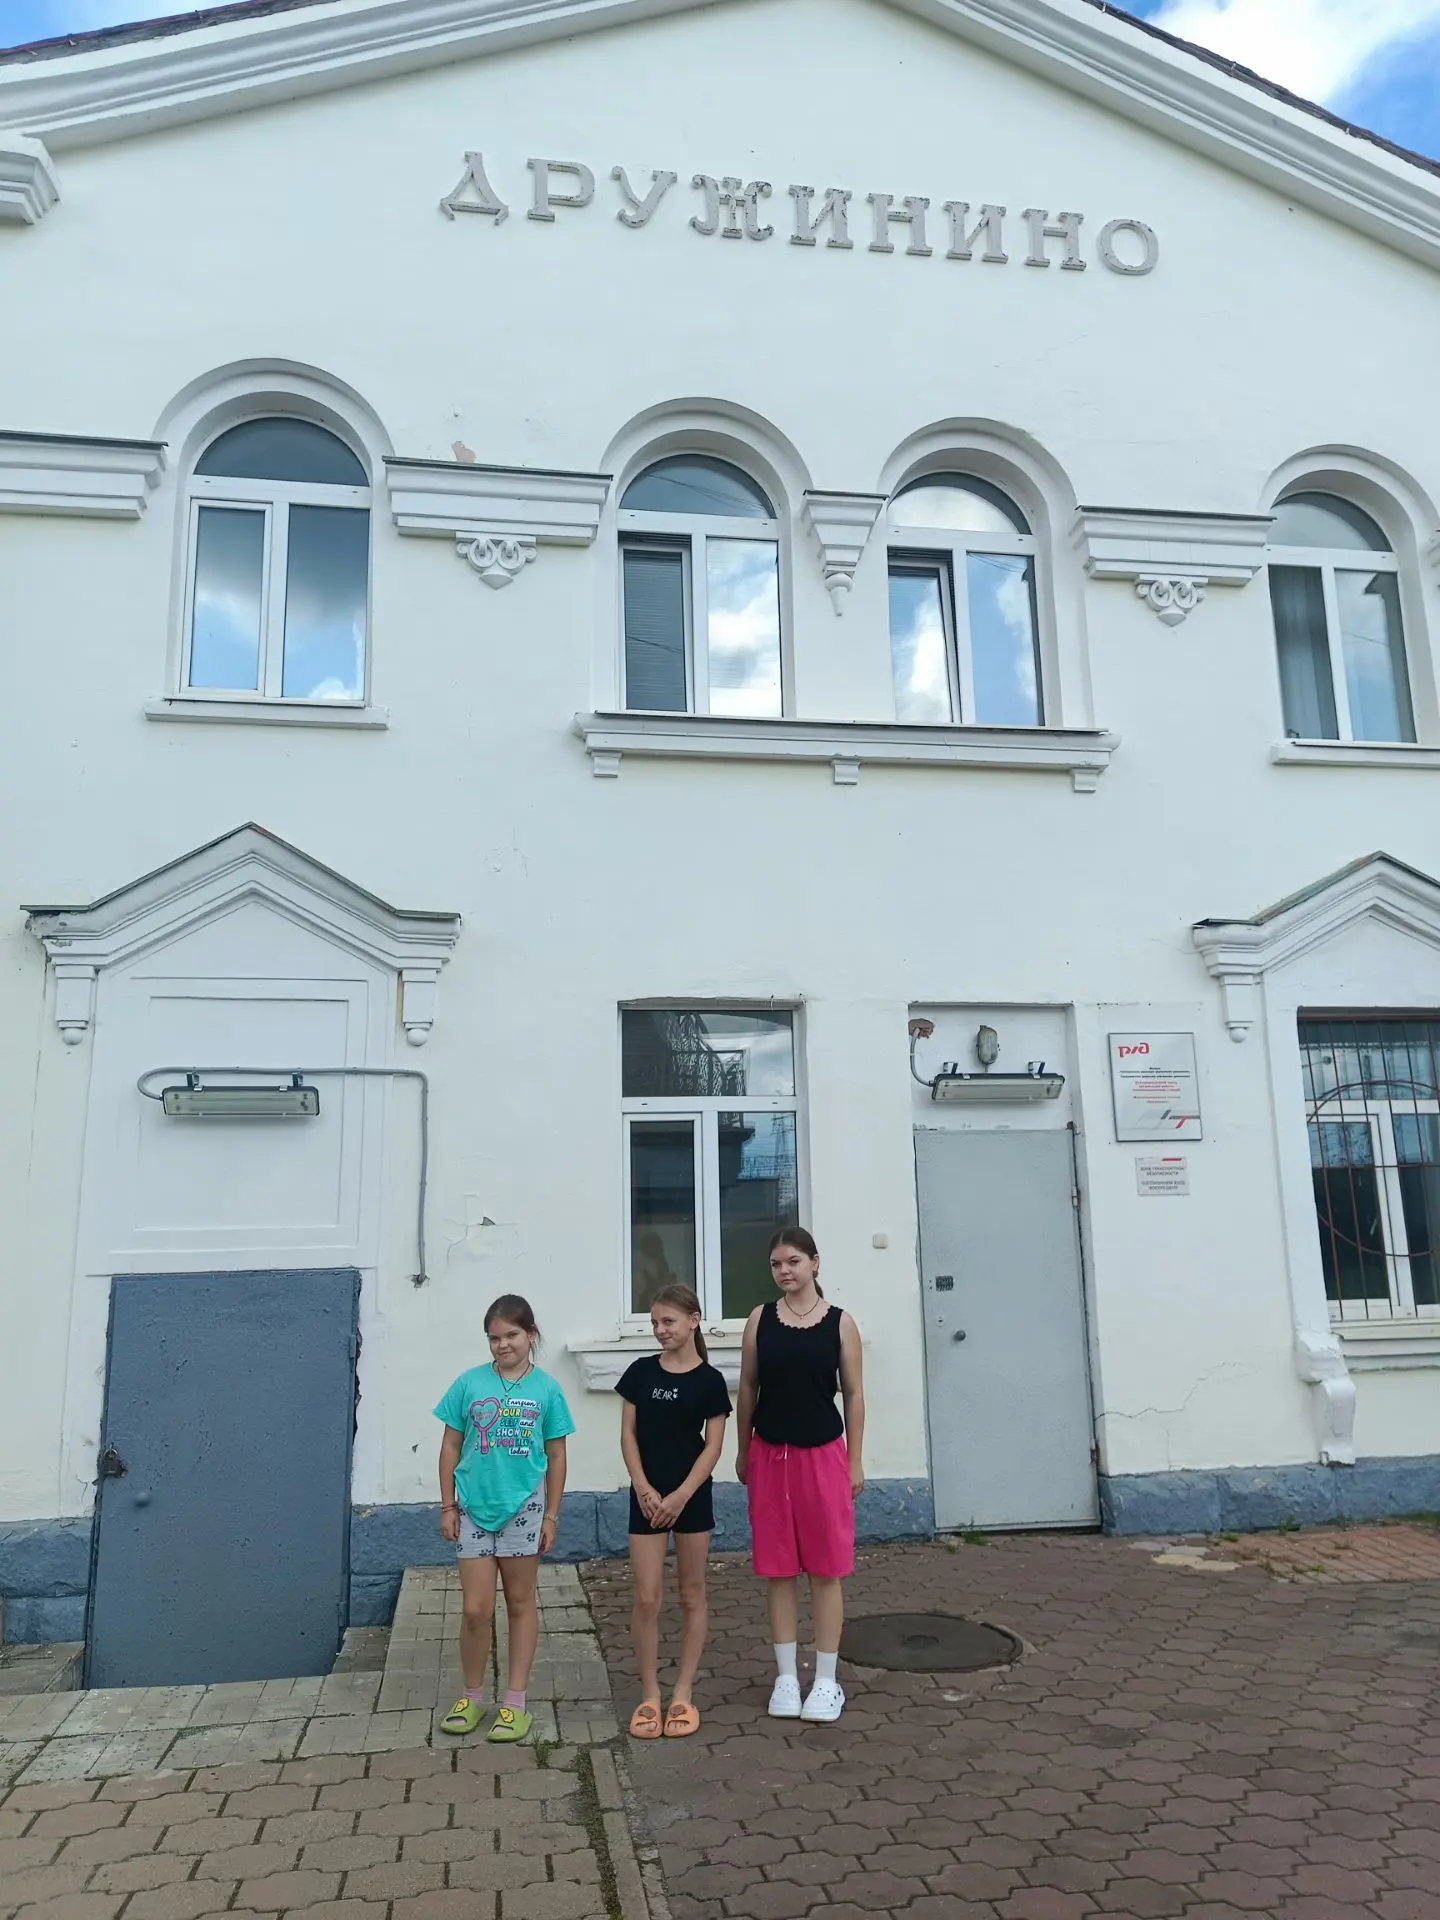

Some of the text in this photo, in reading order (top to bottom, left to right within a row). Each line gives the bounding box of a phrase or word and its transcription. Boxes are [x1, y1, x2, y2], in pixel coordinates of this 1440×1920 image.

[440, 151, 1159, 275] ДРУЖИНИНО
[652, 1388, 673, 1401] BEAR
[498, 1408, 521, 1417] YOUR
[519, 1419, 535, 1427] and
[496, 1428, 533, 1438] SHOW UP
[510, 1447, 531, 1458] today
